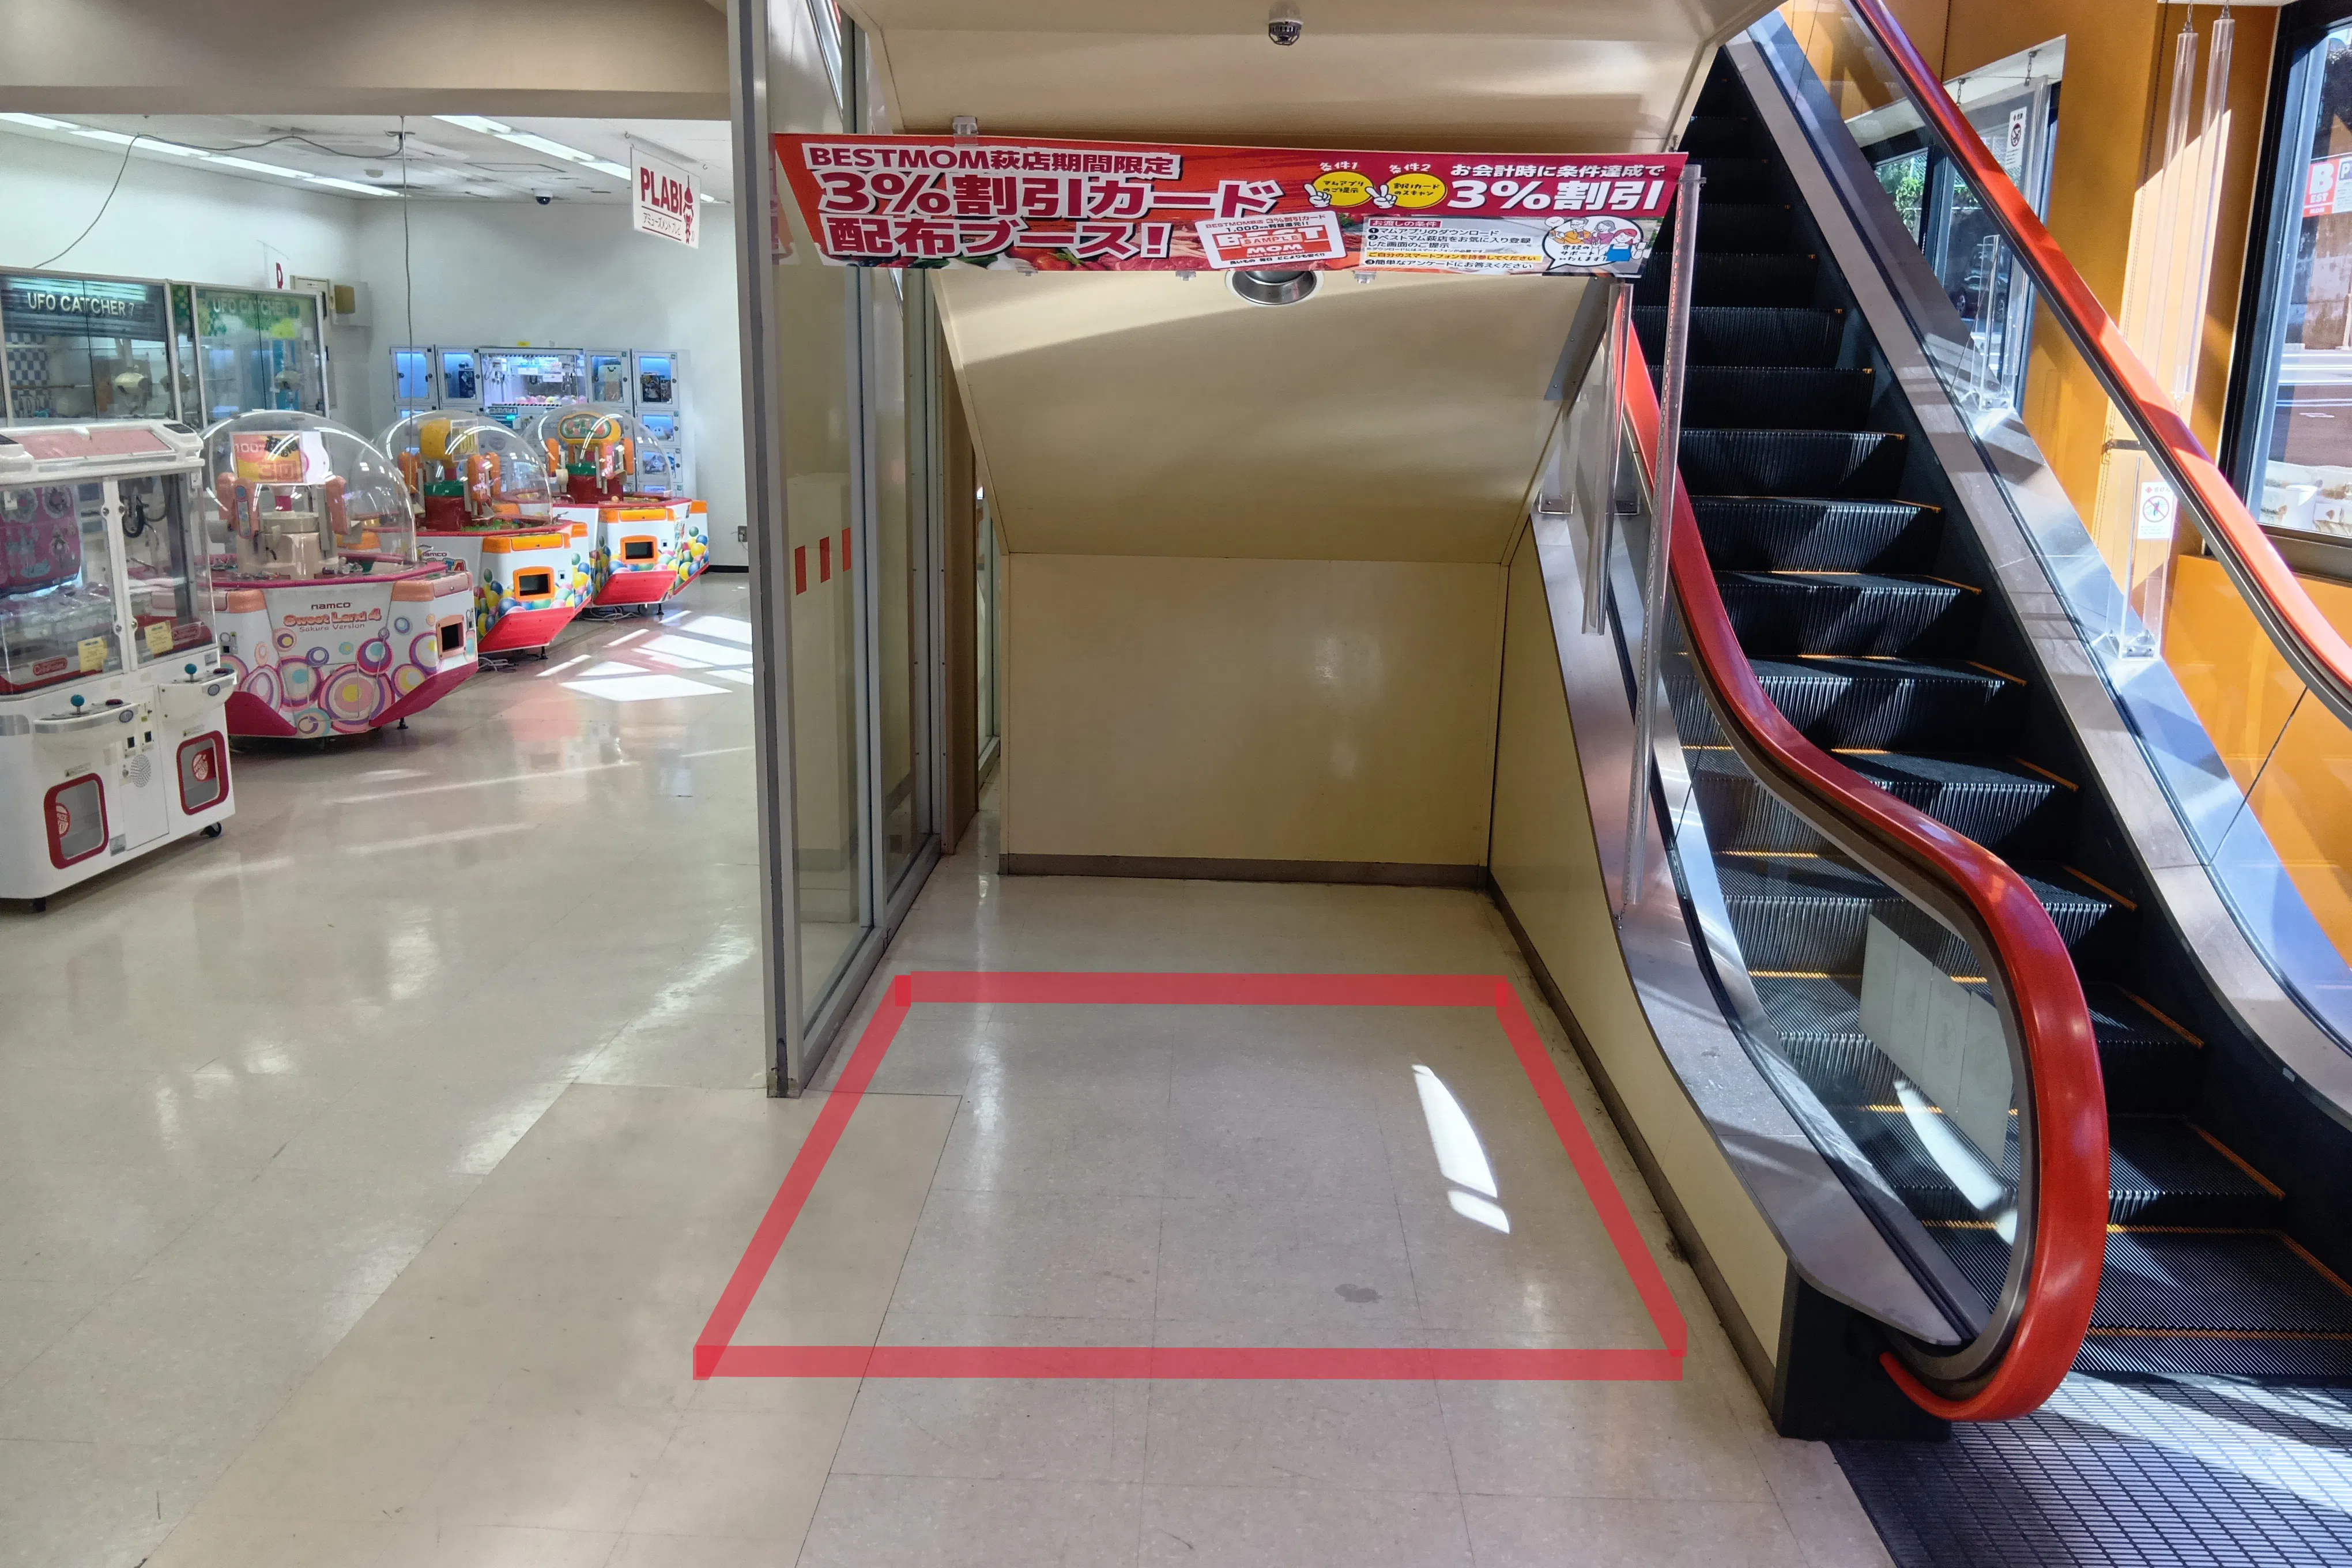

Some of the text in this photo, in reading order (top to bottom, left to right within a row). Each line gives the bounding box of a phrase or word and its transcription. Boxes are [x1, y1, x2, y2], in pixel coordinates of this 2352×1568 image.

[809, 148, 1174, 175] BESTMOM萩店期間限定
[1450, 164, 1665, 178] お会計時に条件達成で
[640, 167, 683, 216] PLABI
[820, 172, 1276, 218] 3%割引カード
[1447, 180, 1665, 210] 3%割引
[1372, 220, 1438, 228] お渡しの条件
[1244, 235, 1299, 244] SAMPLE
[1247, 244, 1303, 254] MOM
[1369, 251, 1536, 261] ご自分のスマートフォンを持参してください
[27, 292, 56, 311] UFO
[61, 296, 126, 316] CATCHER
[311, 602, 352, 610] namco
[283, 608, 382, 627] Sweet Land 4
